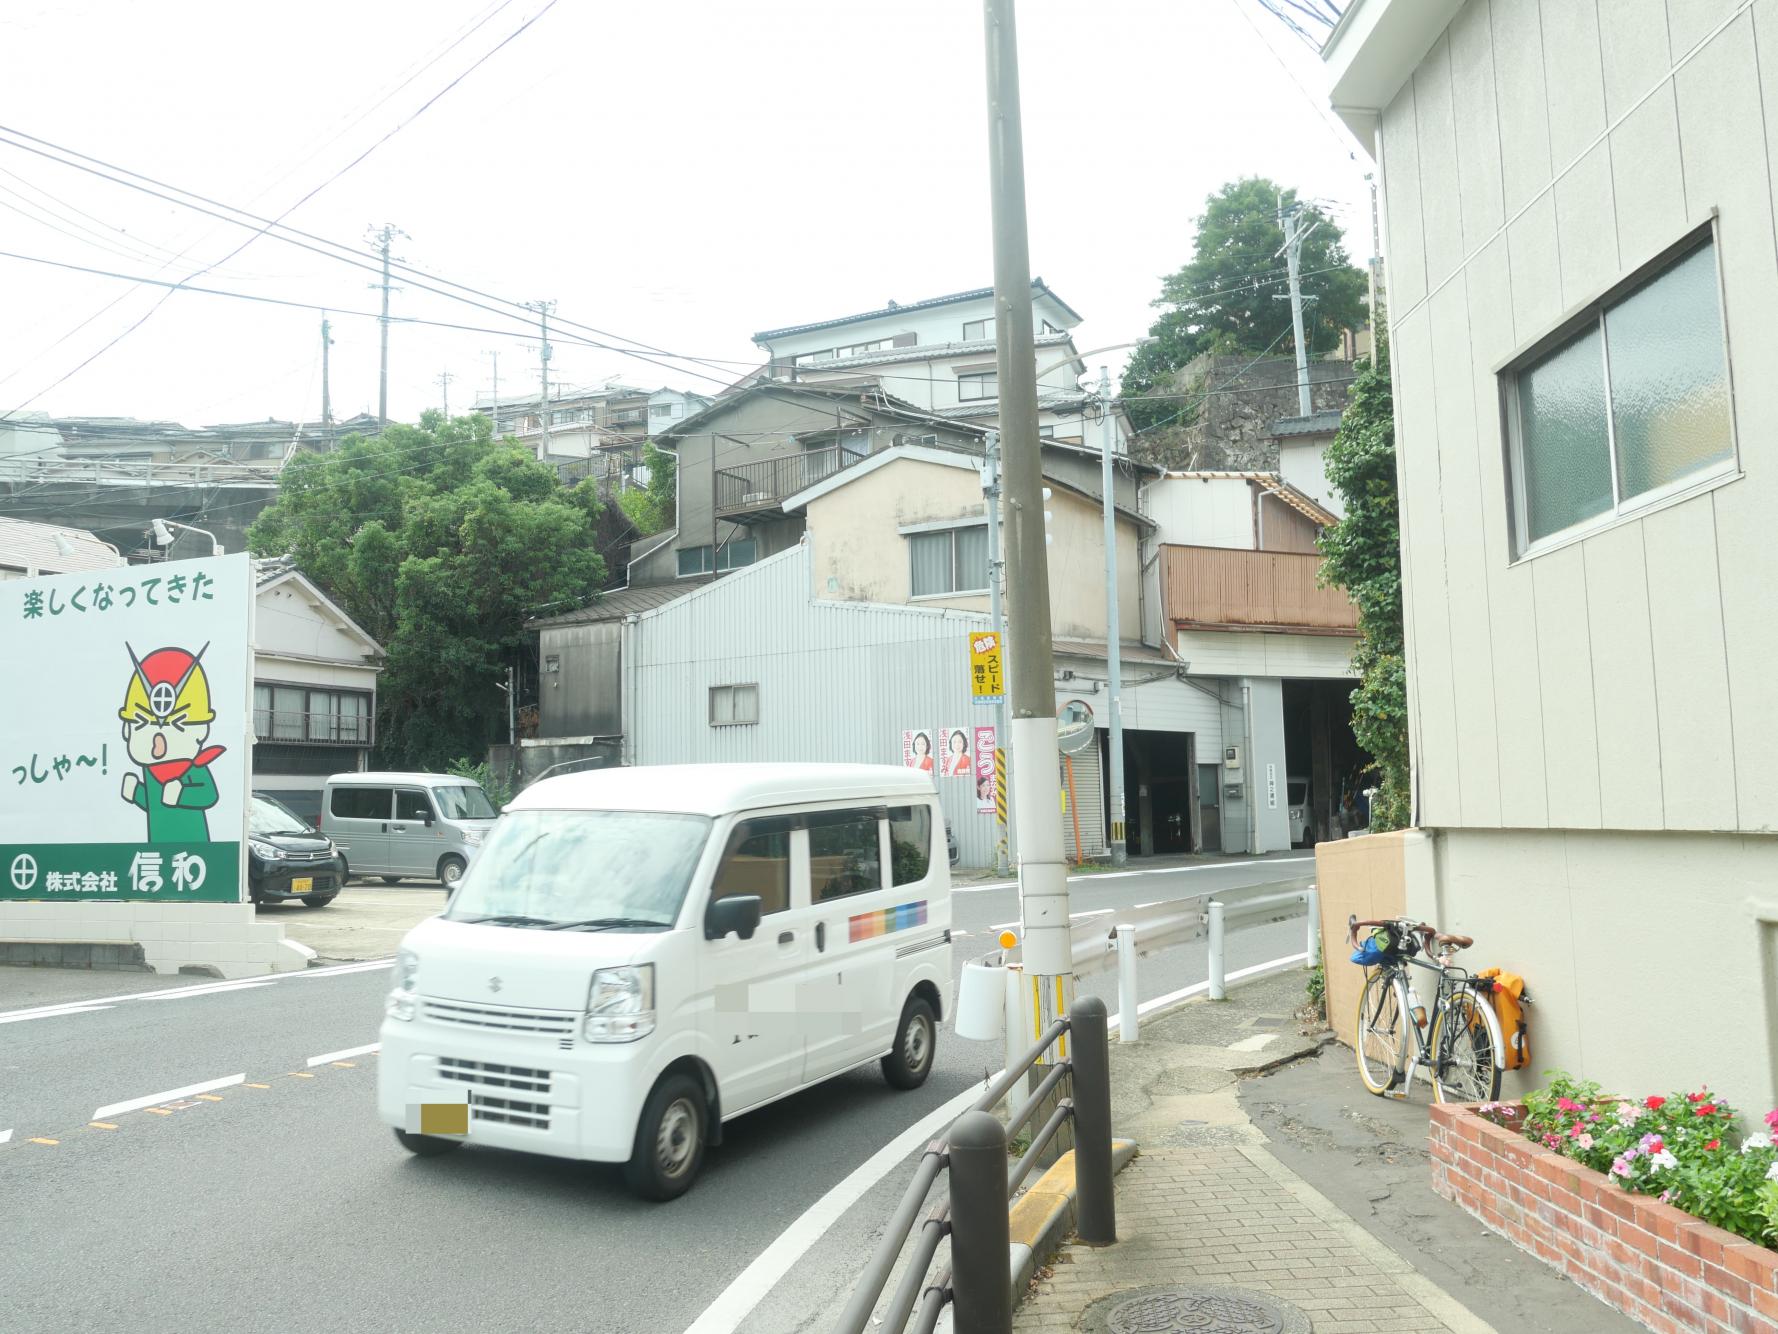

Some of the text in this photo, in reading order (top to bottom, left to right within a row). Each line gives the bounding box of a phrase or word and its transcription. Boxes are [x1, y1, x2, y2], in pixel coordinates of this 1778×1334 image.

[23, 571, 214, 620] 楽しくなってきた
[973, 636, 996, 653] 危険
[987, 655, 1000, 693] スピード
[903, 731, 912, 767] 浅田ます
[46, 871, 118, 892] 株式会社
[129, 851, 206, 892] 信和
